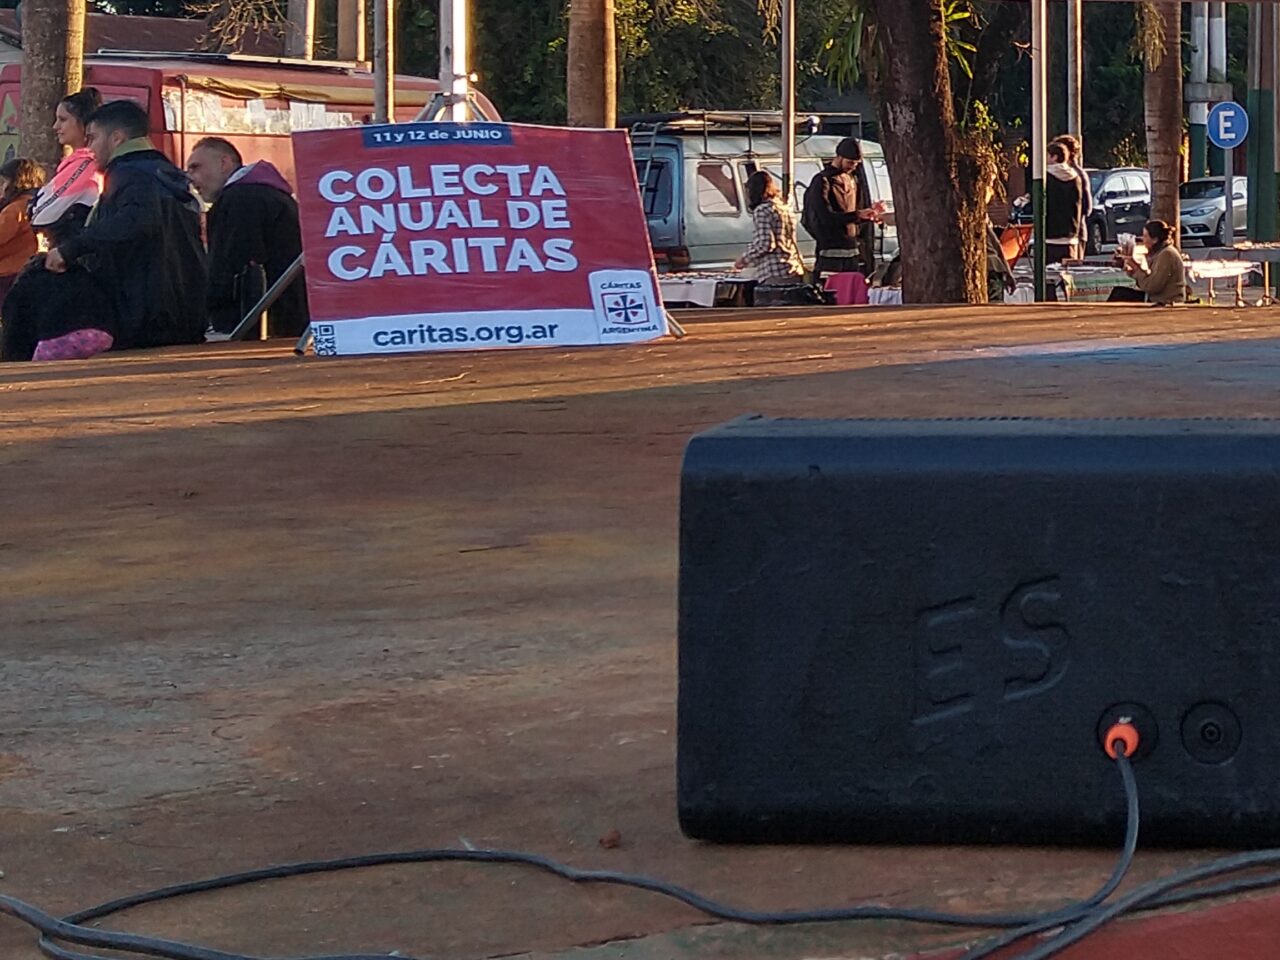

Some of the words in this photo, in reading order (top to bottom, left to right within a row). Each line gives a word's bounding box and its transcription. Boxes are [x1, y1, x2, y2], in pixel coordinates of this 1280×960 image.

[374, 132, 390, 142] 11
[394, 133, 404, 142] y
[408, 131, 425, 140] 12
[428, 130, 449, 140] de
[453, 129, 502, 139] JUNIO
[1219, 111, 1235, 139] E
[318, 164, 565, 203] COLECTA
[325, 200, 498, 237] ANUAL
[507, 199, 571, 229] DE
[327, 233, 579, 281] CÁRITAS
[373, 323, 558, 347] caritas.org.ar
